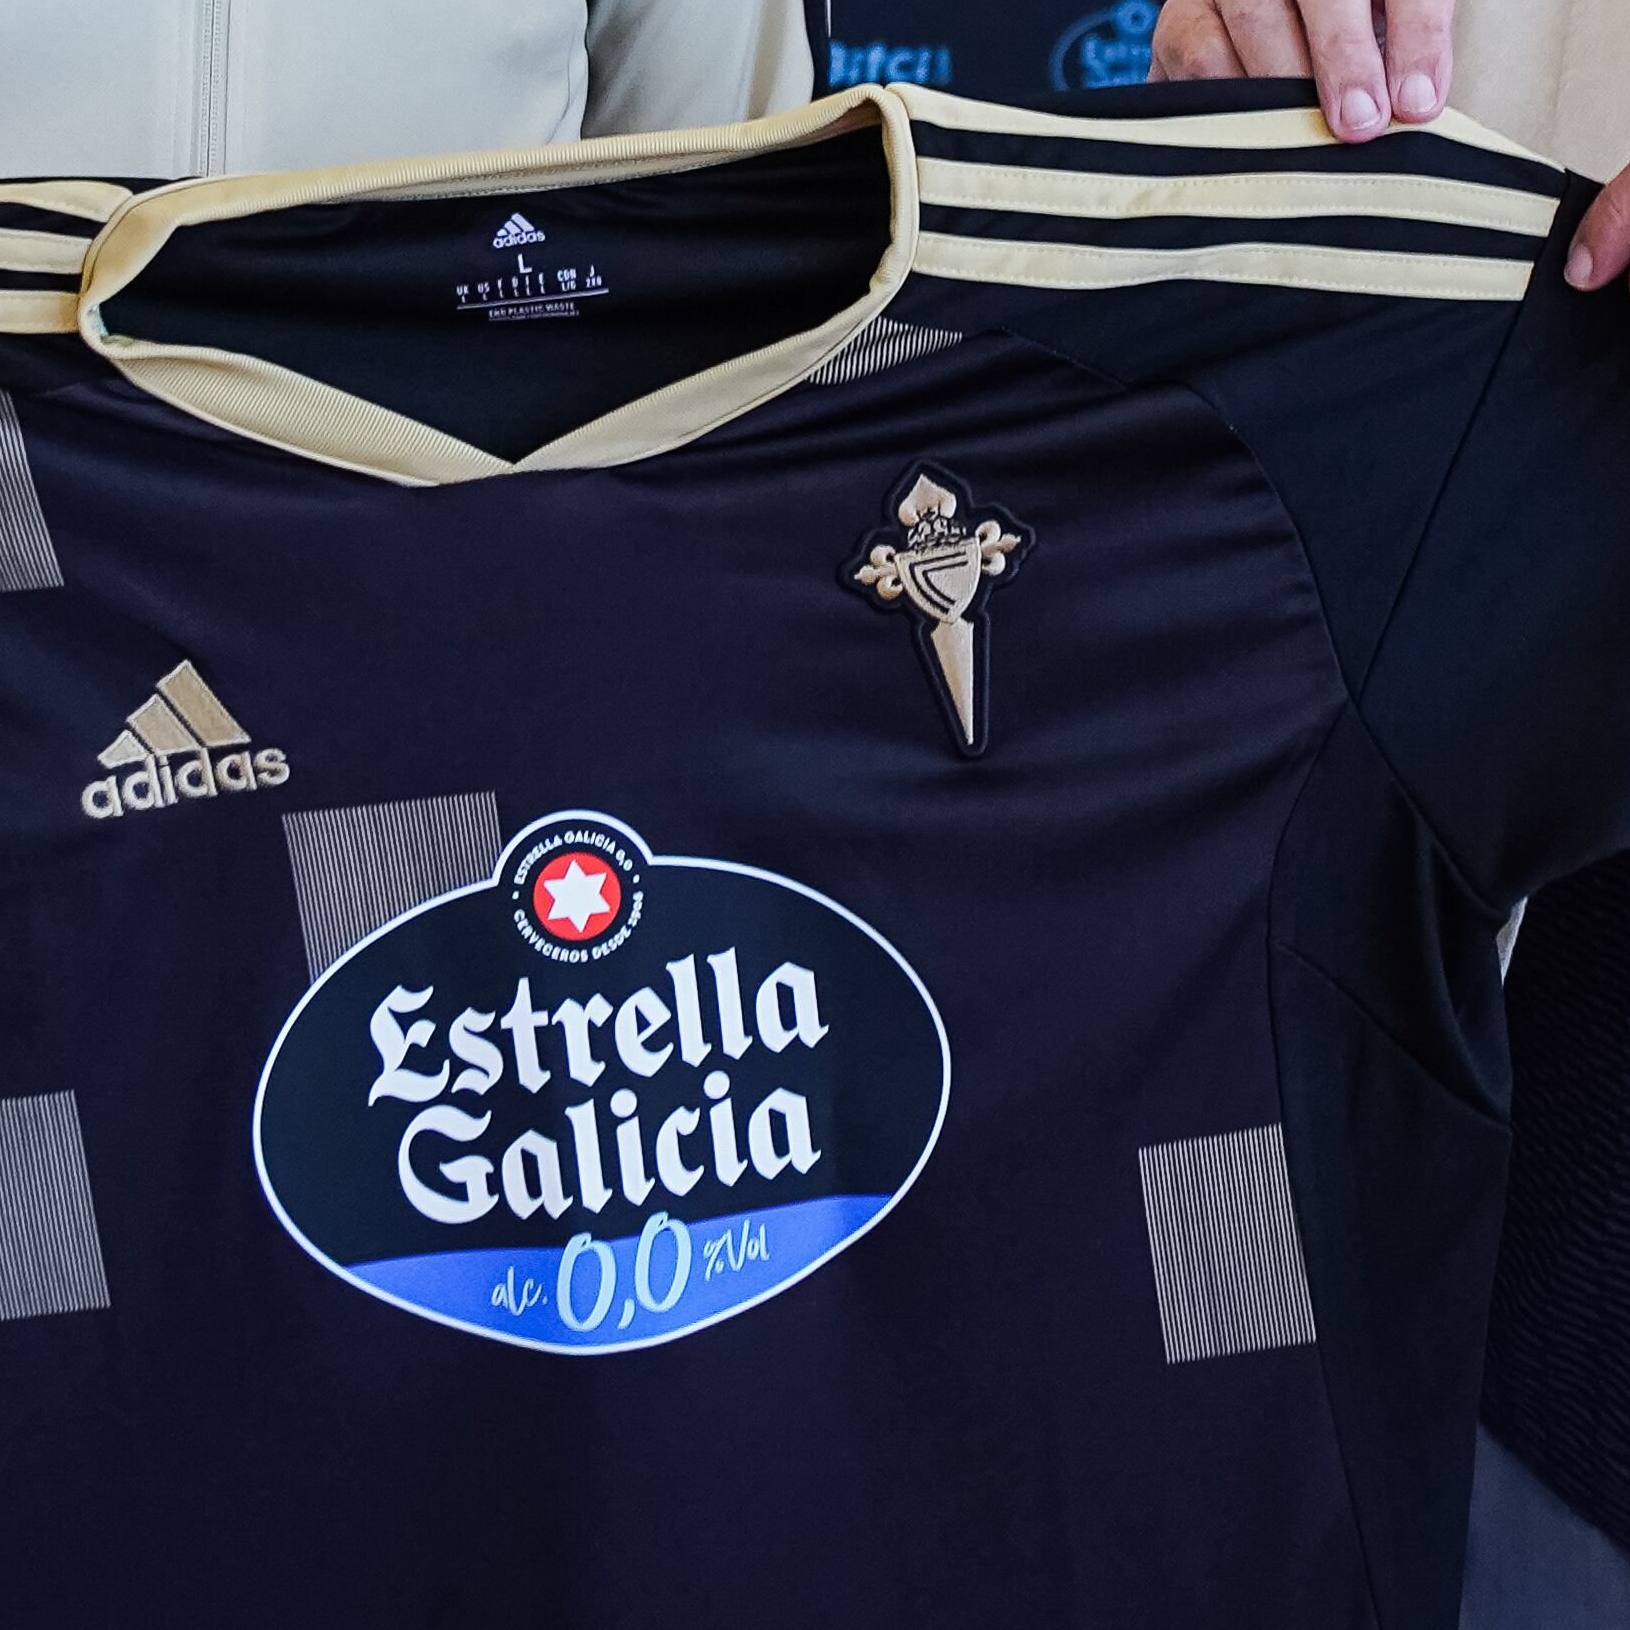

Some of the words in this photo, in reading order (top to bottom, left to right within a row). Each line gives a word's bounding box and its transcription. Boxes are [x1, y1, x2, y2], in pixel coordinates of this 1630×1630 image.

[492, 230, 546, 249] adidas
[518, 253, 533, 273] L
[81, 747, 290, 819] adidas
[564, 830, 617, 855] GALICIA
[514, 909, 588, 963] CERVECEROS
[591, 925, 632, 960] DESDE
[368, 946, 829, 1107] Estrella
[398, 1070, 823, 1224] Galicia
[490, 1265, 548, 1317] alc.
[555, 1211, 693, 1332] 0,0
